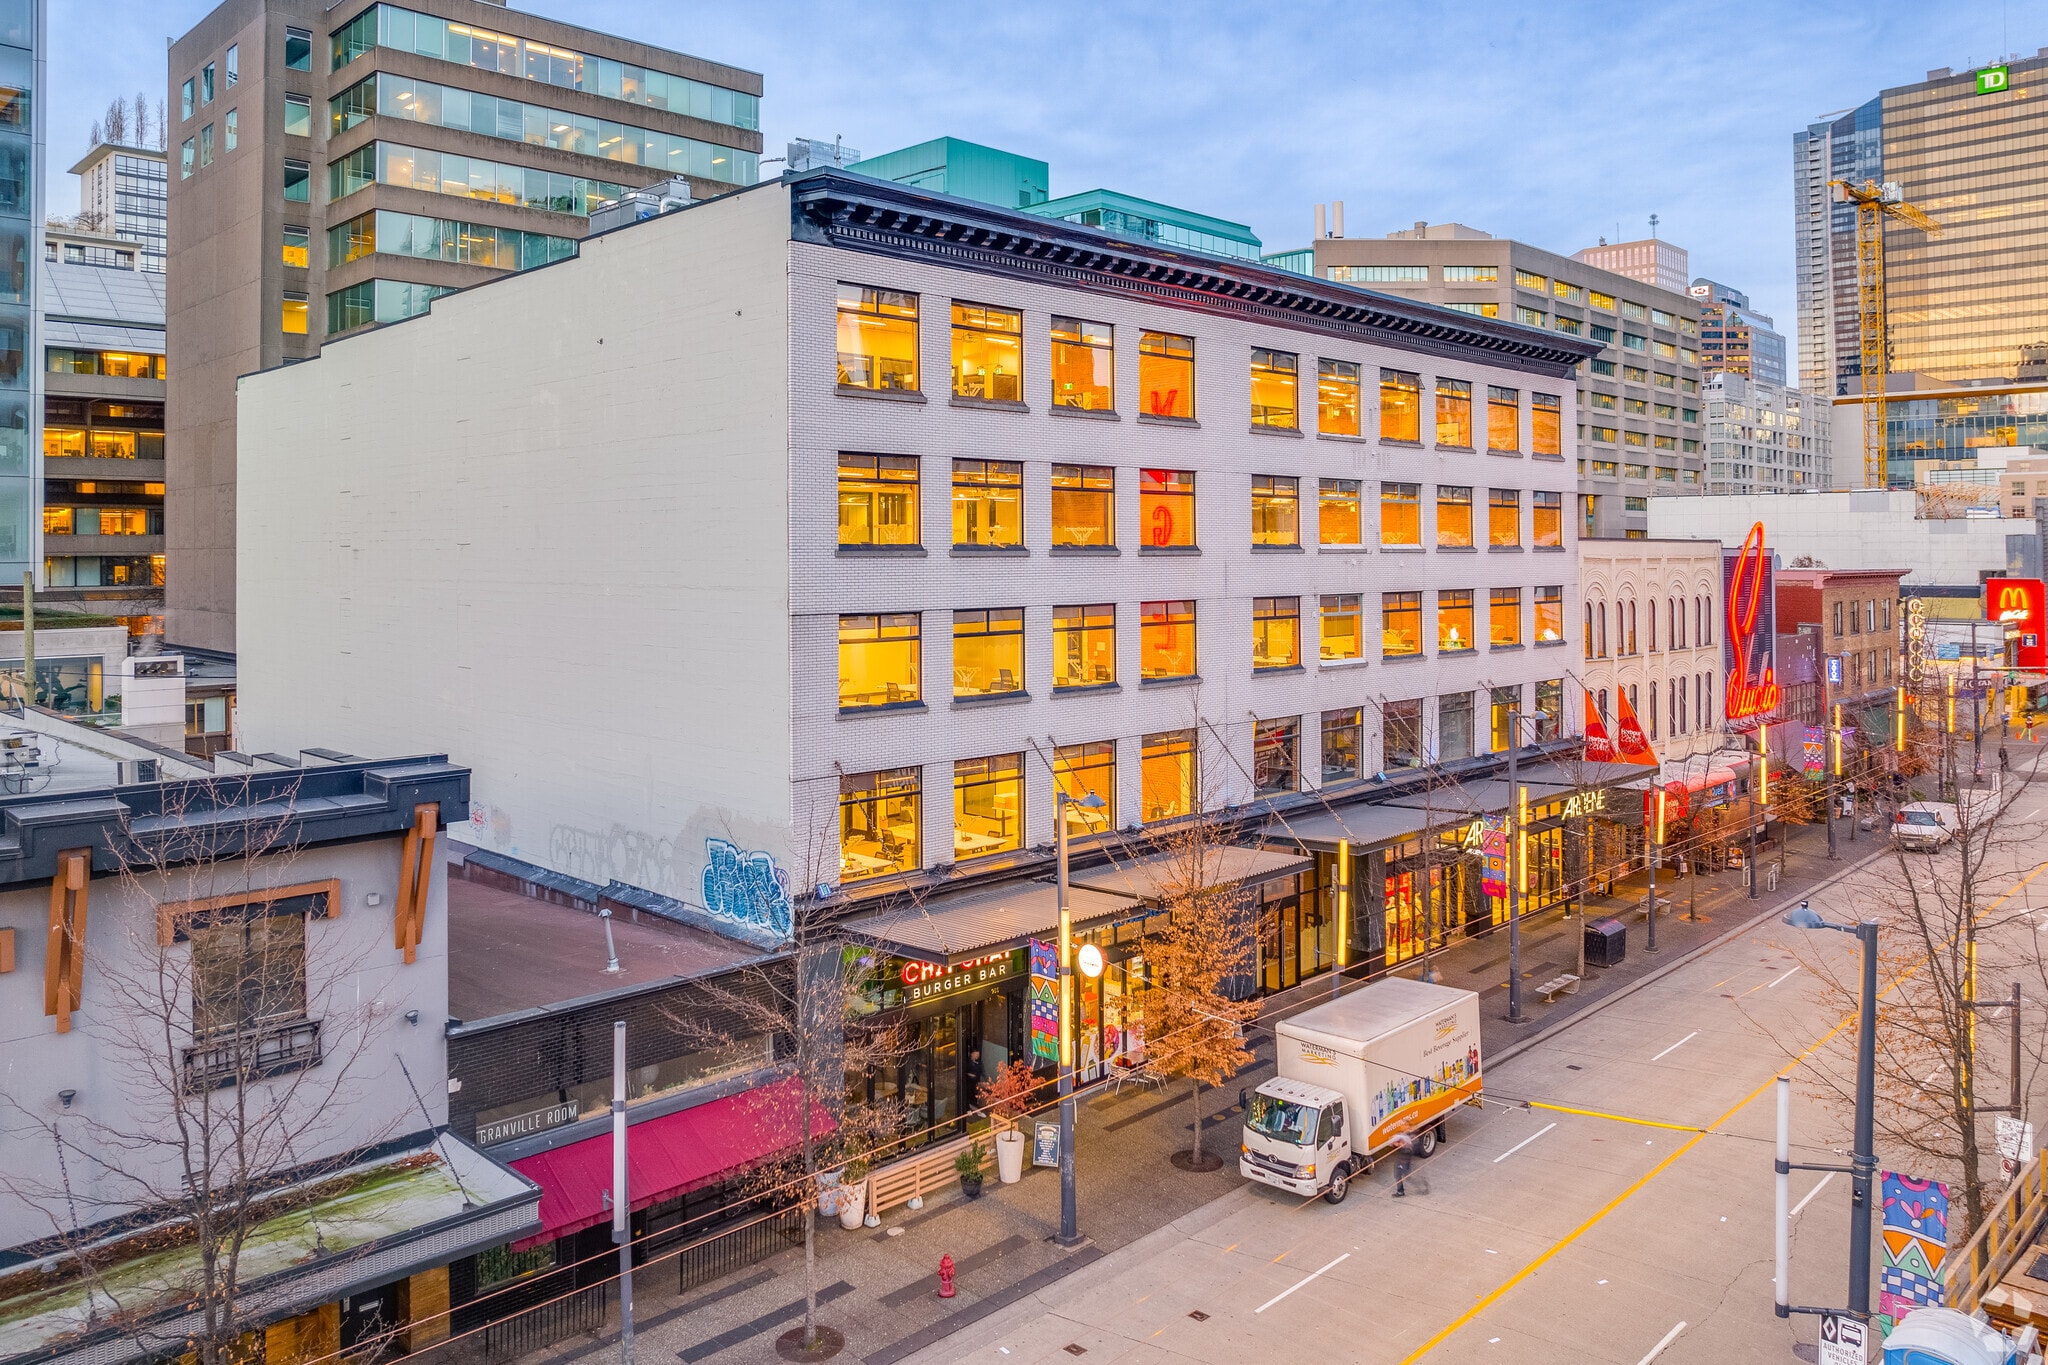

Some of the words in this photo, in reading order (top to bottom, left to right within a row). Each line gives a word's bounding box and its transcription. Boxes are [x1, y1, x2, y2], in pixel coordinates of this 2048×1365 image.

[1980, 71, 2005, 89] TD
[912, 974, 972, 999] BURGER
[979, 964, 1006, 981] BAR
[480, 1114, 541, 1145] GRANVILLE
[547, 1104, 577, 1125] ROOM
[1822, 1342, 1864, 1362] AUTHORIZED
